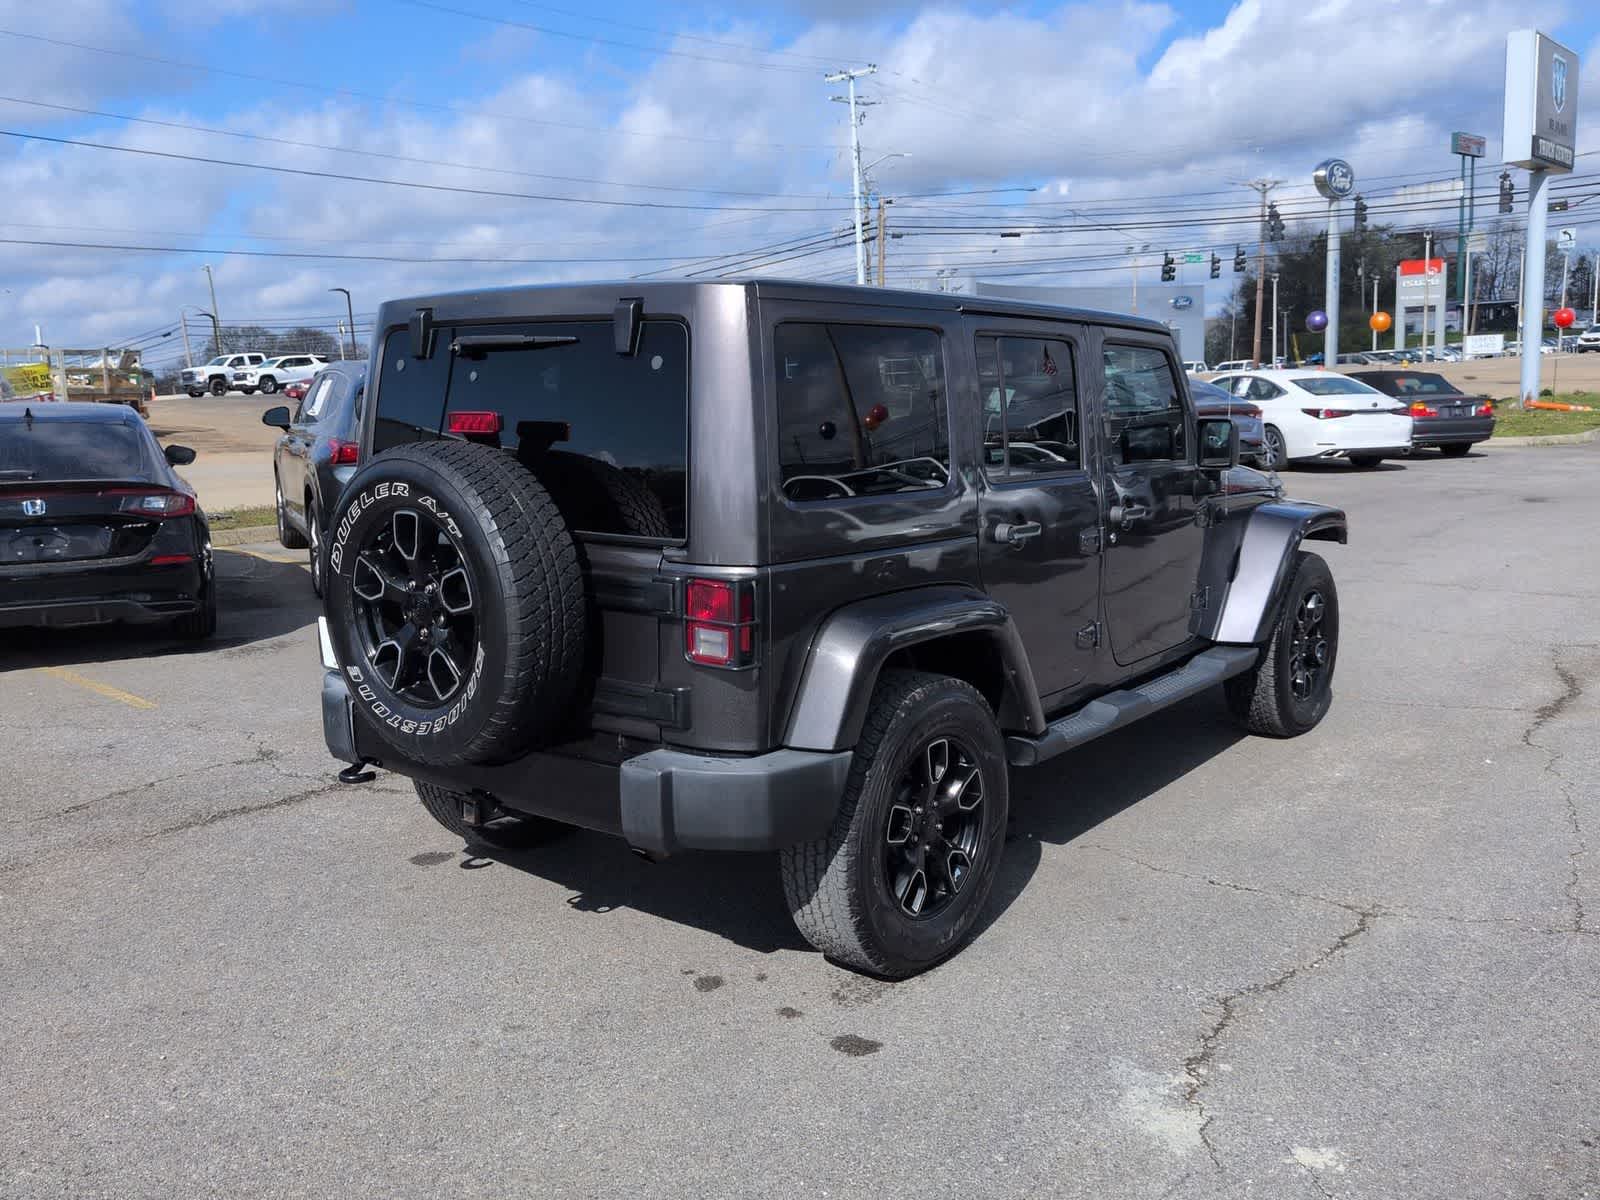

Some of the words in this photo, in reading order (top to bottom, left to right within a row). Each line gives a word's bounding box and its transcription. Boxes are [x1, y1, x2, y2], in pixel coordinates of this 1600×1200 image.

[1331, 164, 1351, 190] Ford
[331, 482, 409, 574] DUELER
[346, 643, 485, 735] BRIDGESTONE
